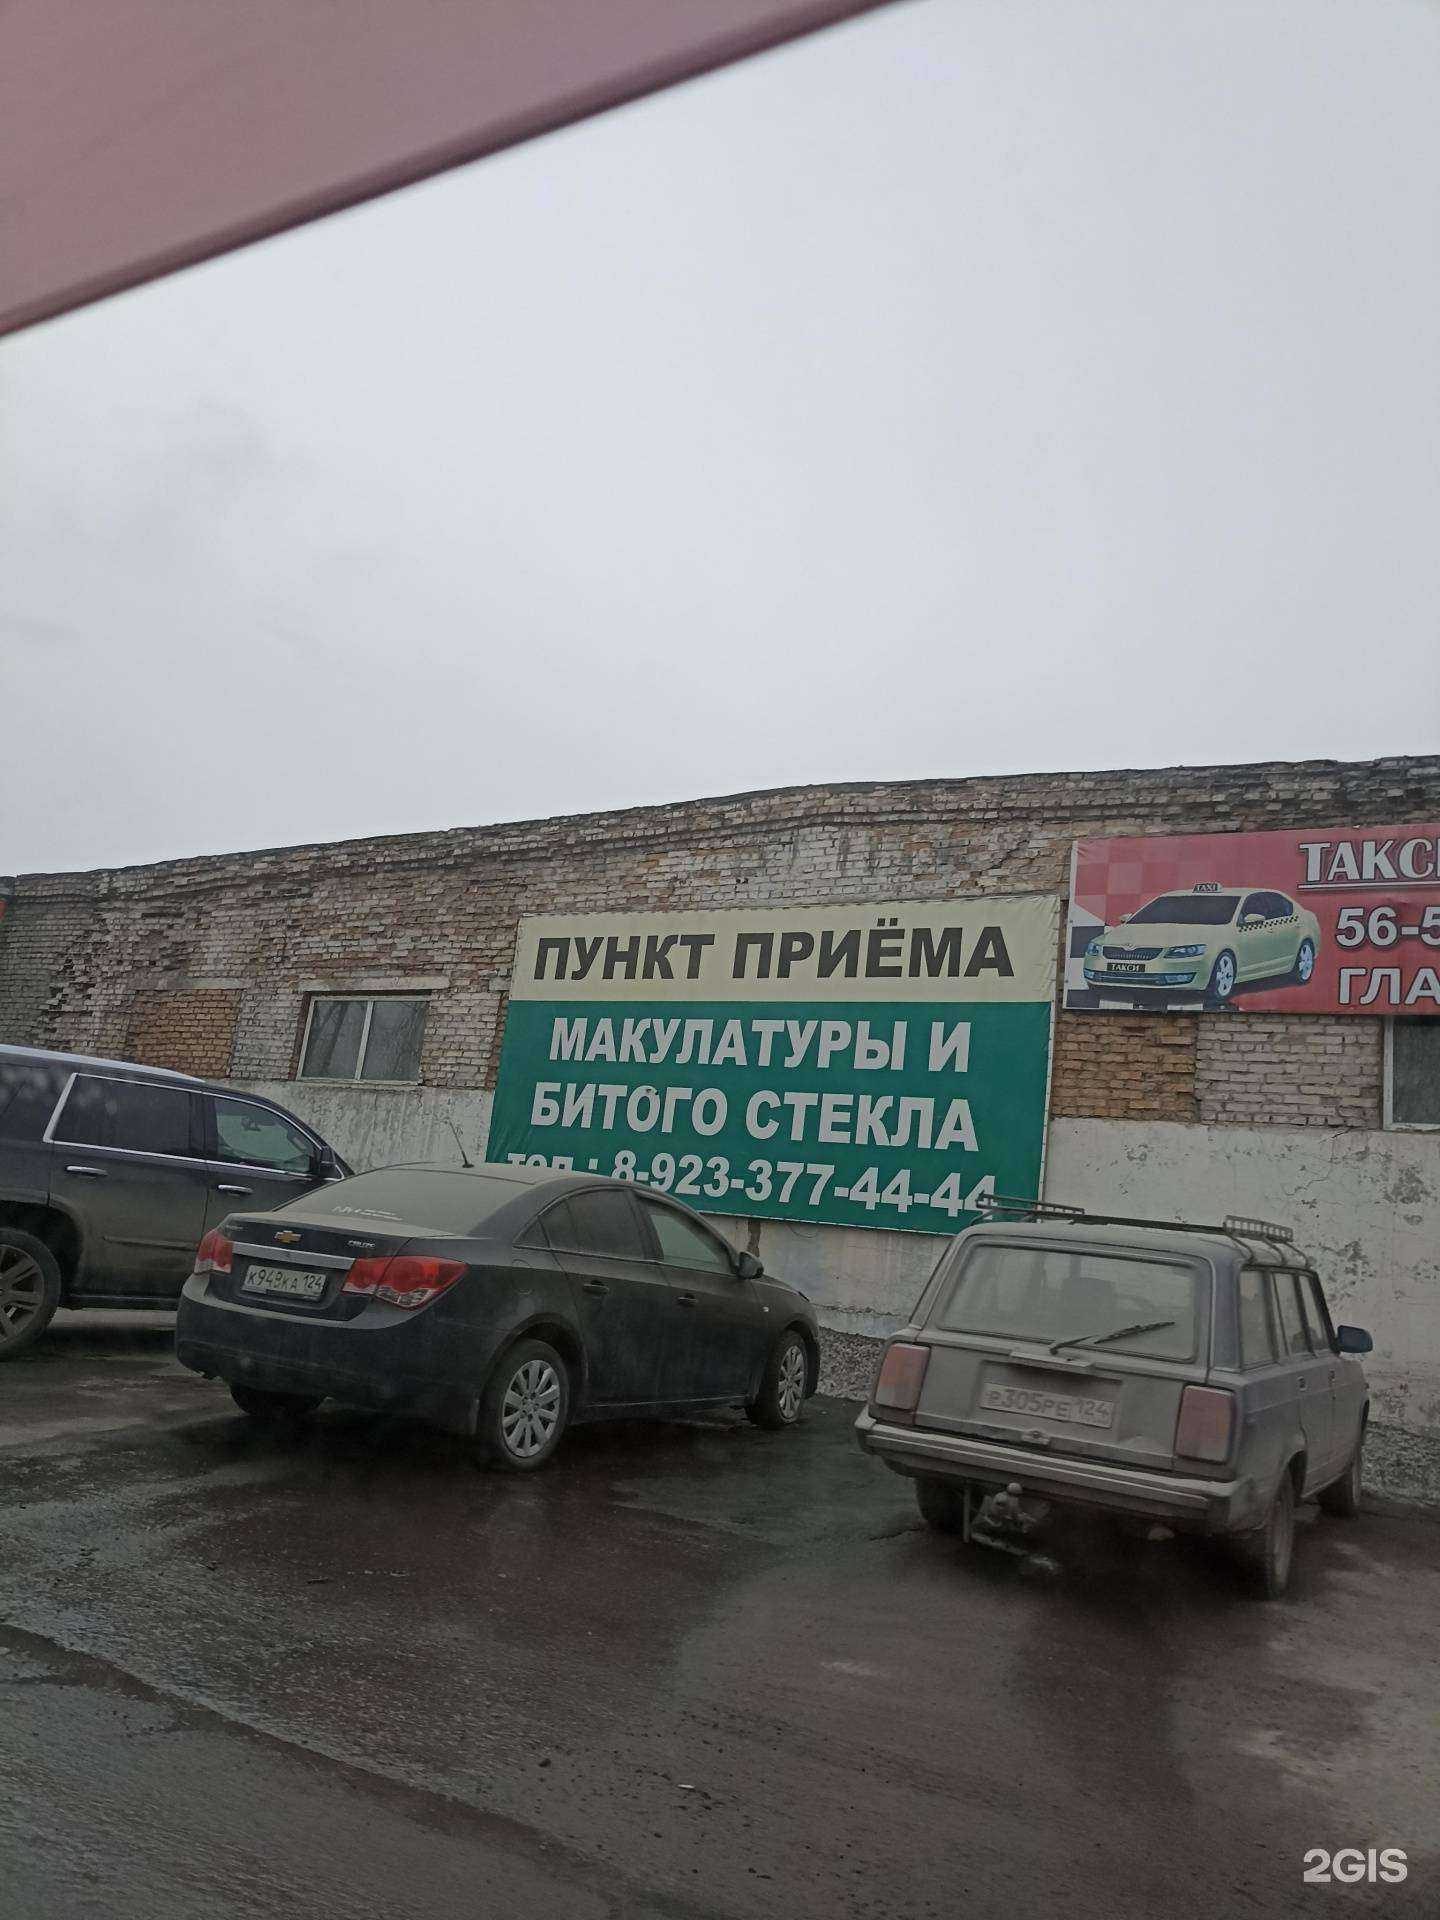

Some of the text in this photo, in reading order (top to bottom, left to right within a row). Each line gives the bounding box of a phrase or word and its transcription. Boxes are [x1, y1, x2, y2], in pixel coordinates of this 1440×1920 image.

[1196, 883, 1217, 892] TAXI
[533, 917, 1015, 980] ПУНКТ ПРИЁМА
[549, 1017, 972, 1073] МАКУЛАТУРЫ И
[530, 1081, 979, 1152] БИТОГО СТЕКЛА
